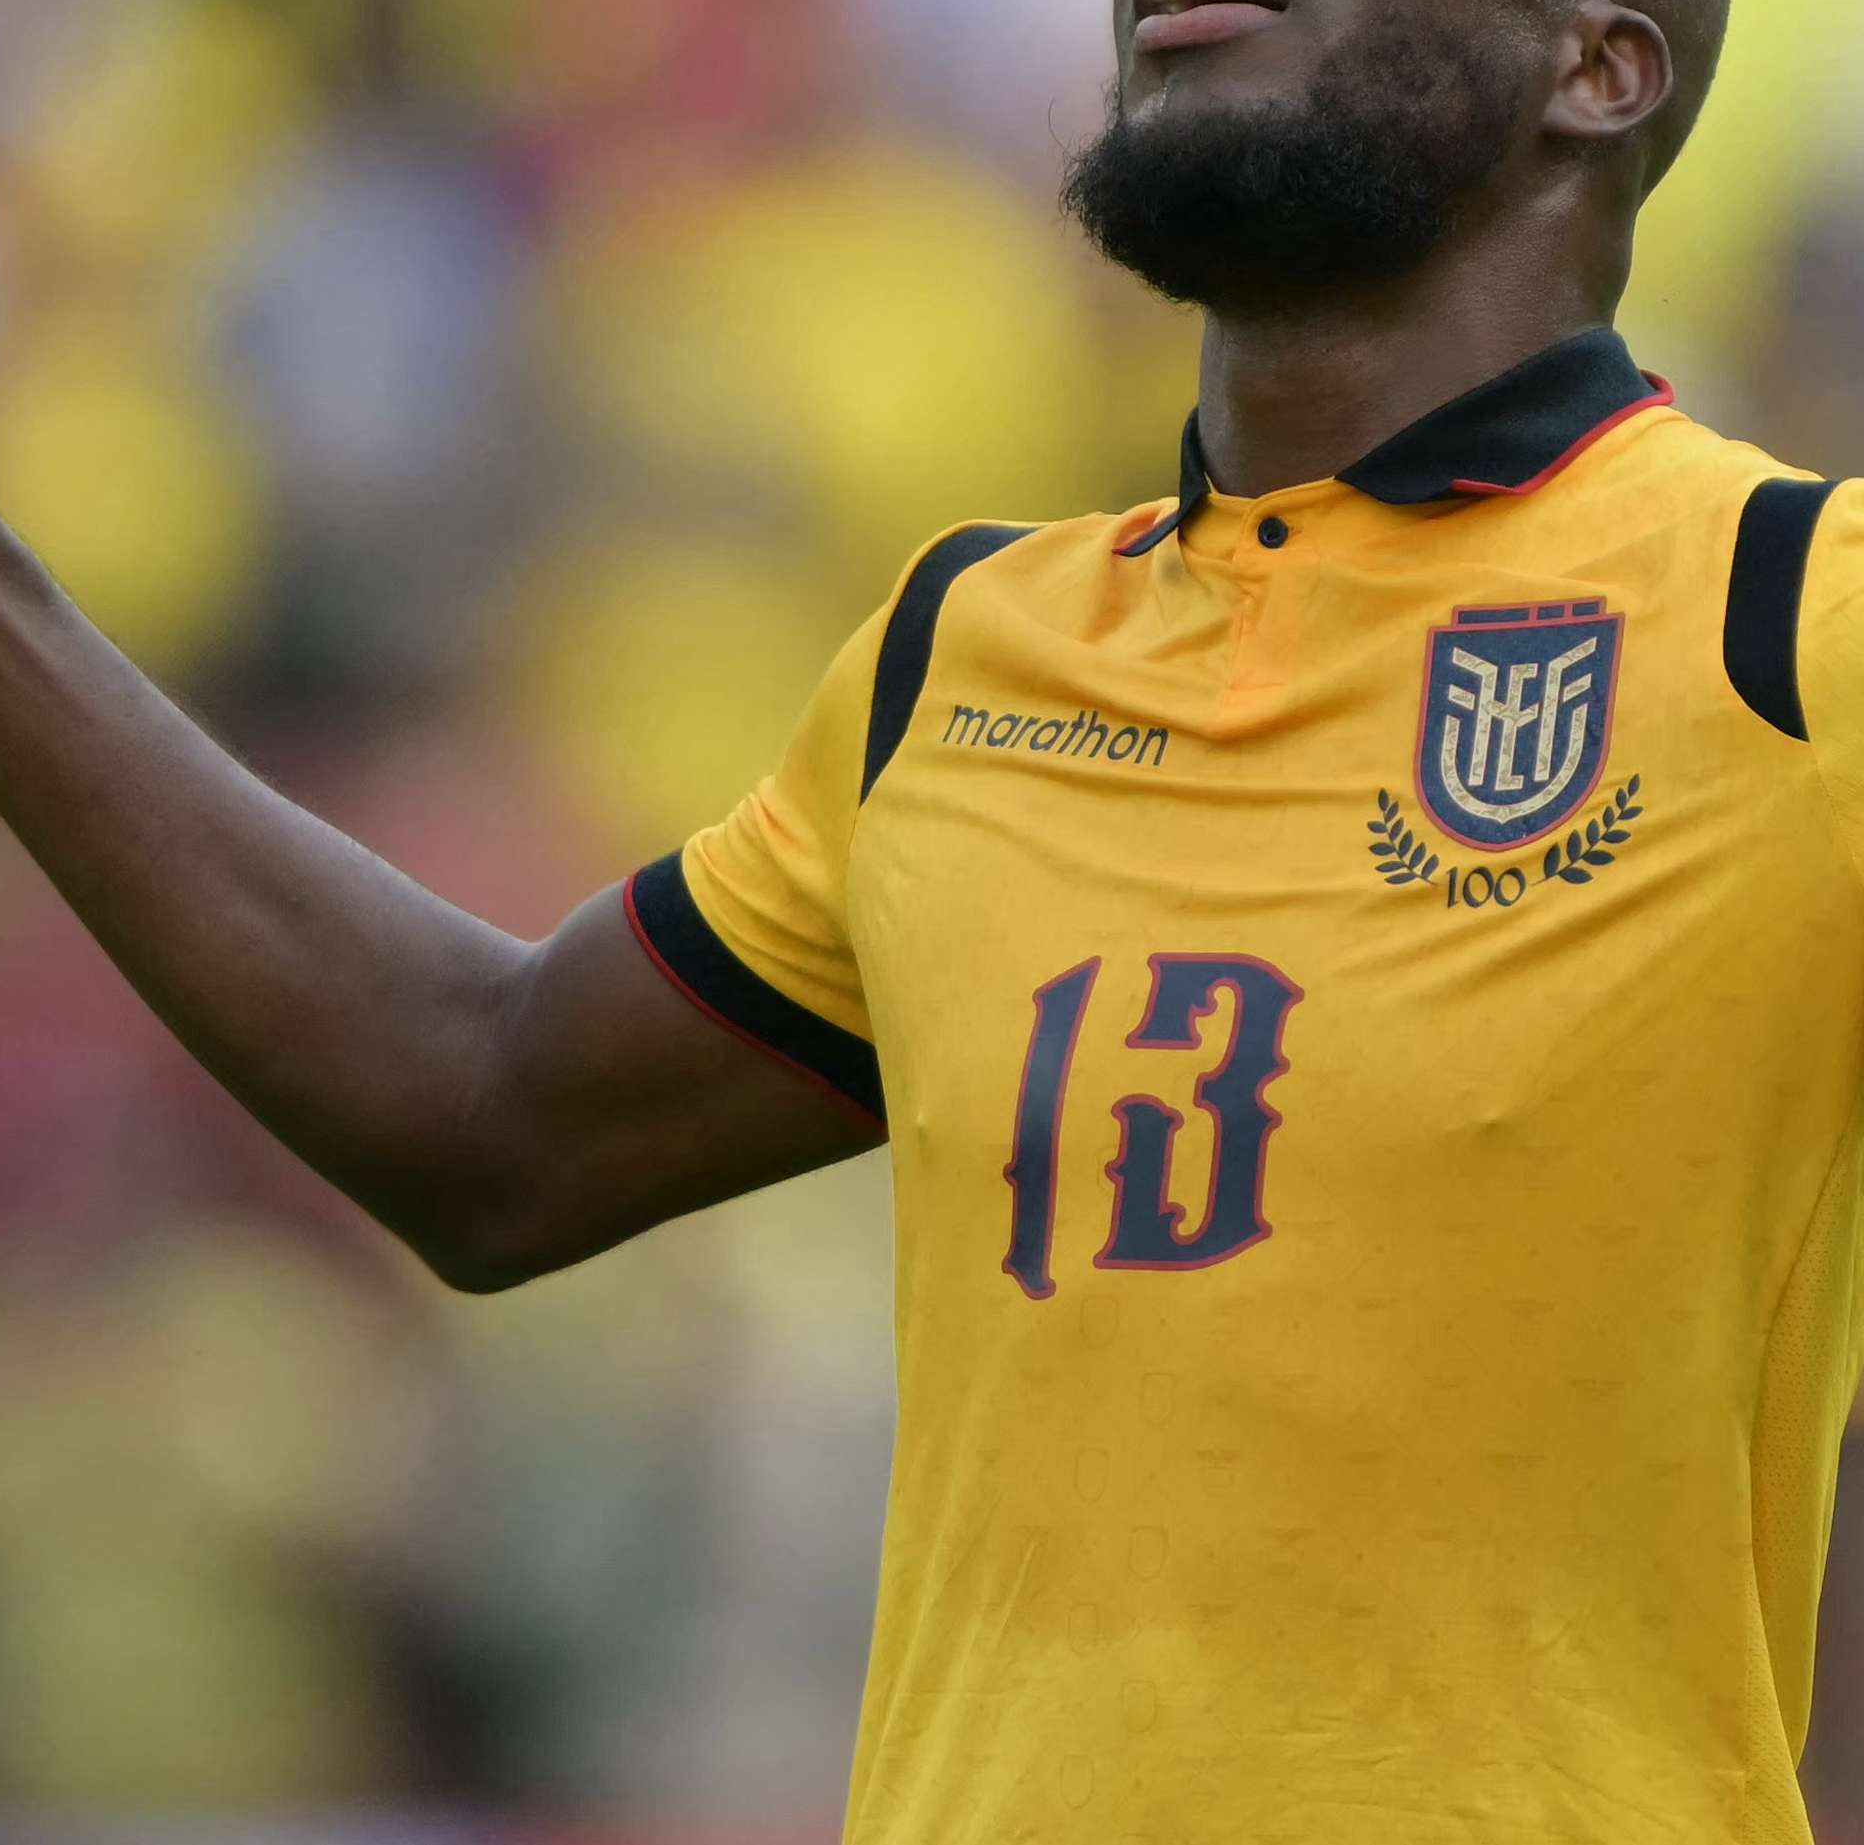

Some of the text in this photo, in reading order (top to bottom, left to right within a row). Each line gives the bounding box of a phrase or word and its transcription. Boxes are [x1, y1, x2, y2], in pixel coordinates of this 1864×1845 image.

[942, 703, 1171, 767] marathon
[1445, 864, 1528, 909] 100
[1002, 952, 1306, 1301] 13
